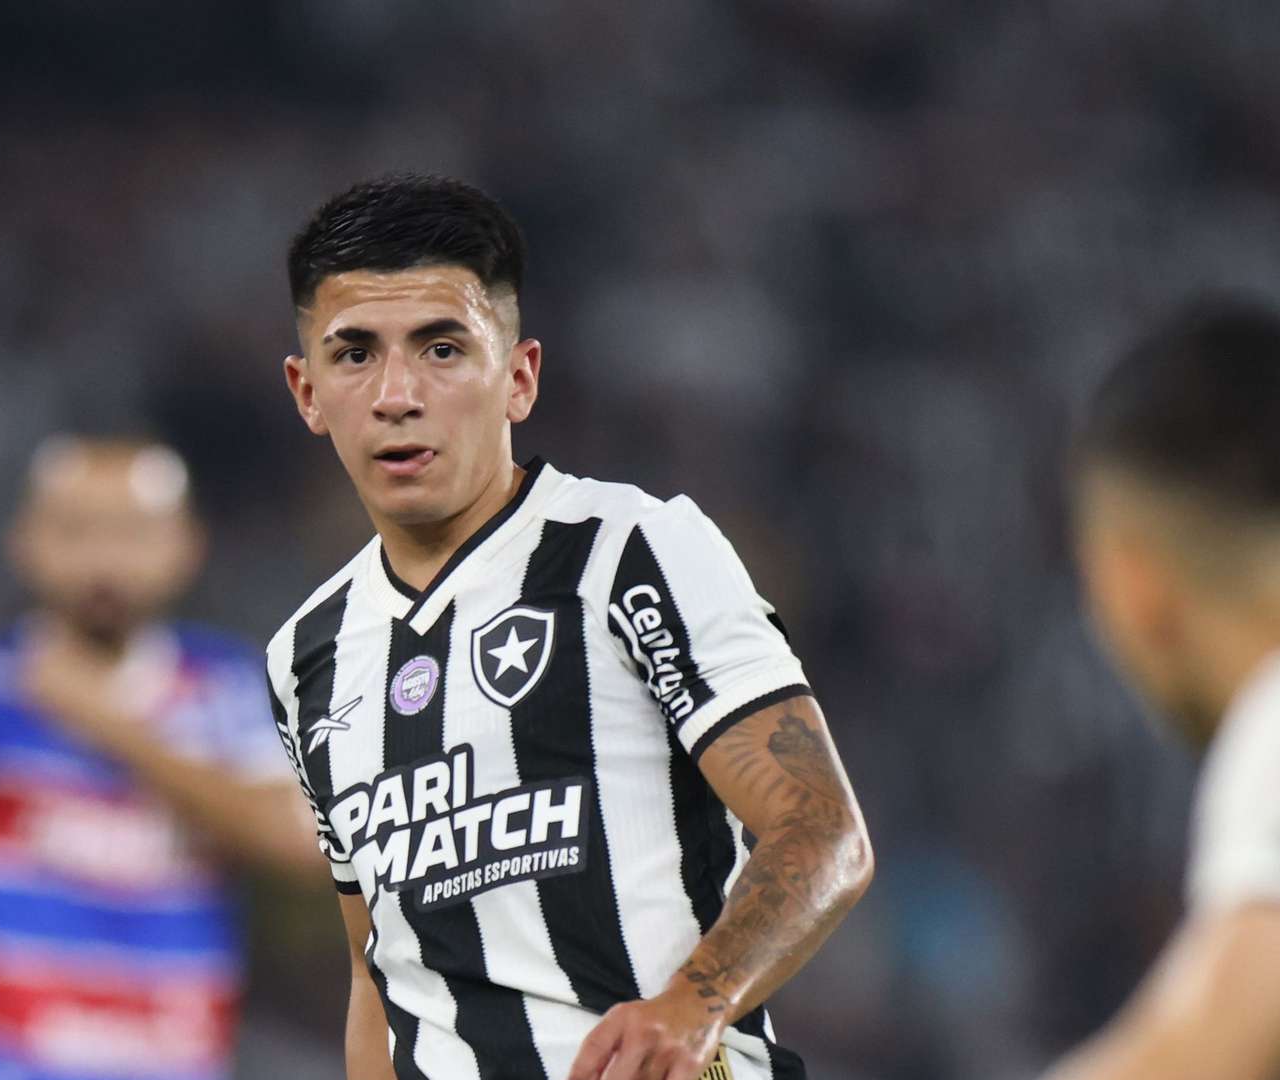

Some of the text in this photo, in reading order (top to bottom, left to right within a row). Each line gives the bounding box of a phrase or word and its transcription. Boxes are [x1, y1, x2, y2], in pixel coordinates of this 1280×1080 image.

[622, 584, 695, 720] Centrum
[329, 751, 468, 857] PARI
[351, 785, 583, 906] MATCH
[422, 846, 580, 905] APOSTAS ESPORTIVAS
